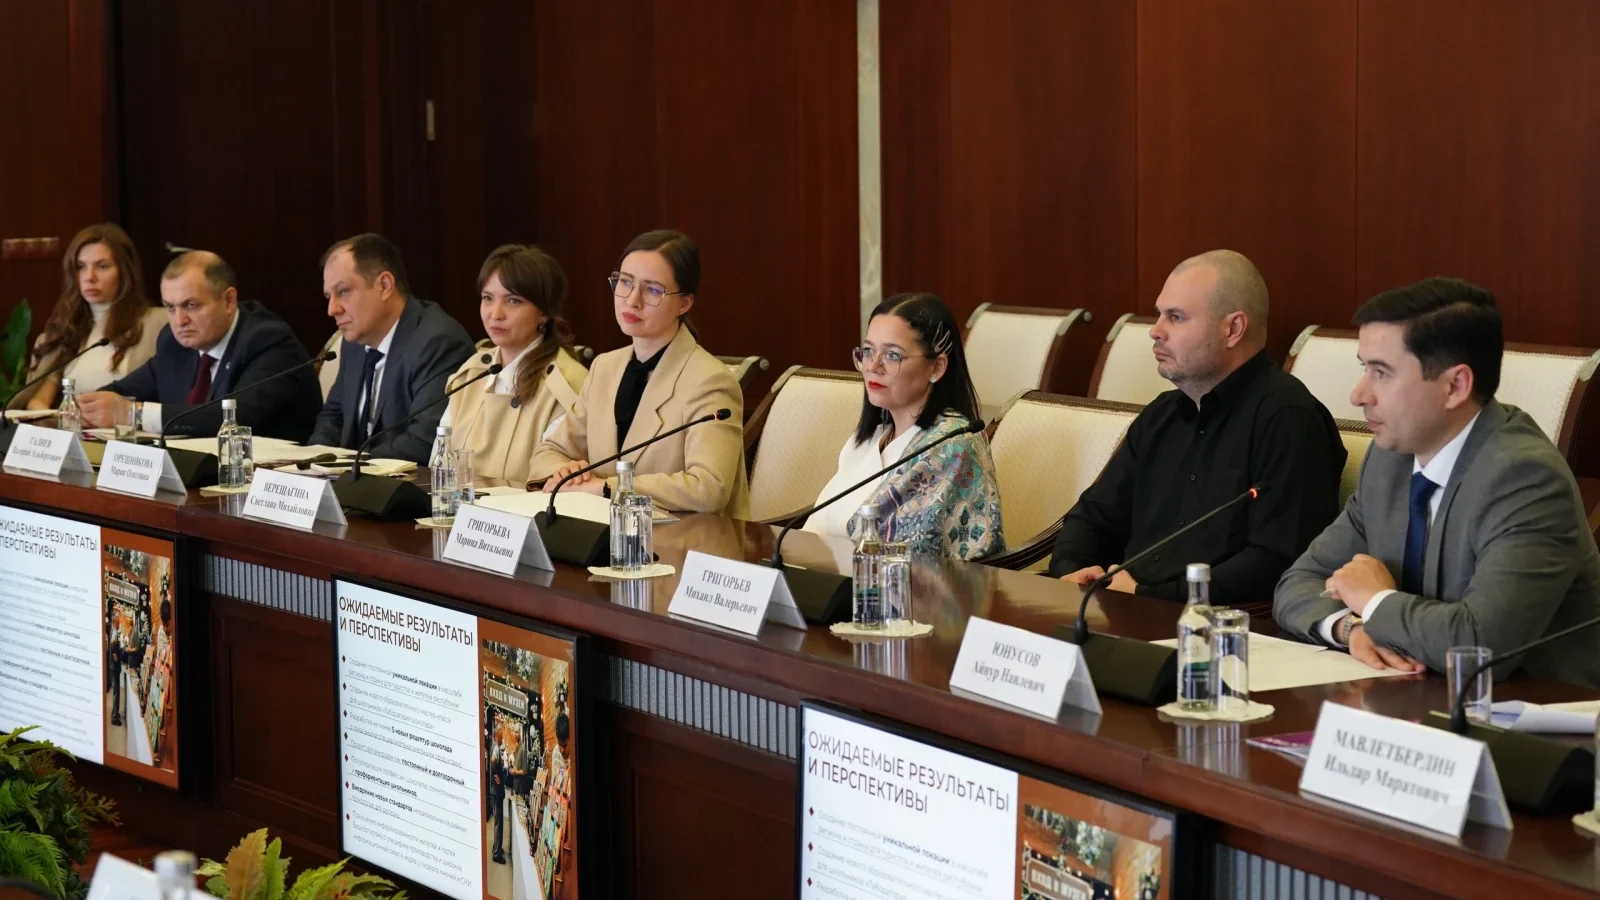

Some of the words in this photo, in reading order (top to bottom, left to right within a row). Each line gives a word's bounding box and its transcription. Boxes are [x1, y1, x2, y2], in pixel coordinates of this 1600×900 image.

[111, 466, 126, 477] Мария
[114, 453, 153, 469] ОРЕШНИКОВА
[263, 482, 309, 500] ВЕРЕЩАГИНА
[250, 495, 276, 509] Светлана
[277, 500, 315, 517] Михайловна
[46, 528, 97, 551] РЕЗУЛЬТАТЫ
[467, 518, 511, 539] ГРИГОРЬЕВА
[455, 533, 477, 548] Марина
[478, 539, 514, 557] Витальевна
[702, 570, 752, 592] ГРИГОРЬЕВ
[684, 586, 712, 603] Михаил
[714, 592, 758, 616] Валерьевич
[339, 596, 404, 627] ОЖИДАЕМЫЕ
[407, 614, 473, 646] РЕЗУЛЬТАТЫ
[340, 616, 347, 631] И
[349, 619, 420, 653] ПЕРСПЕКТИВЫ
[992, 641, 1041, 667] ЮНУСОВ
[391, 670, 417, 685] уникальной
[971, 660, 999, 682] Айнур
[1001, 668, 1046, 694] Наилевич
[1334, 729, 1457, 778] МАВЛЕТБЕРДИН
[809, 731, 904, 778] ОЖИДАЕМЫЕ
[909, 762, 1009, 812] РЕЗУЛЬТАТЫ
[1324, 754, 1371, 785] Ильдар
[1374, 768, 1449, 804] Маратович
[808, 756, 817, 775] И
[822, 761, 927, 813] ПЕРСПЕКТИВЫ
